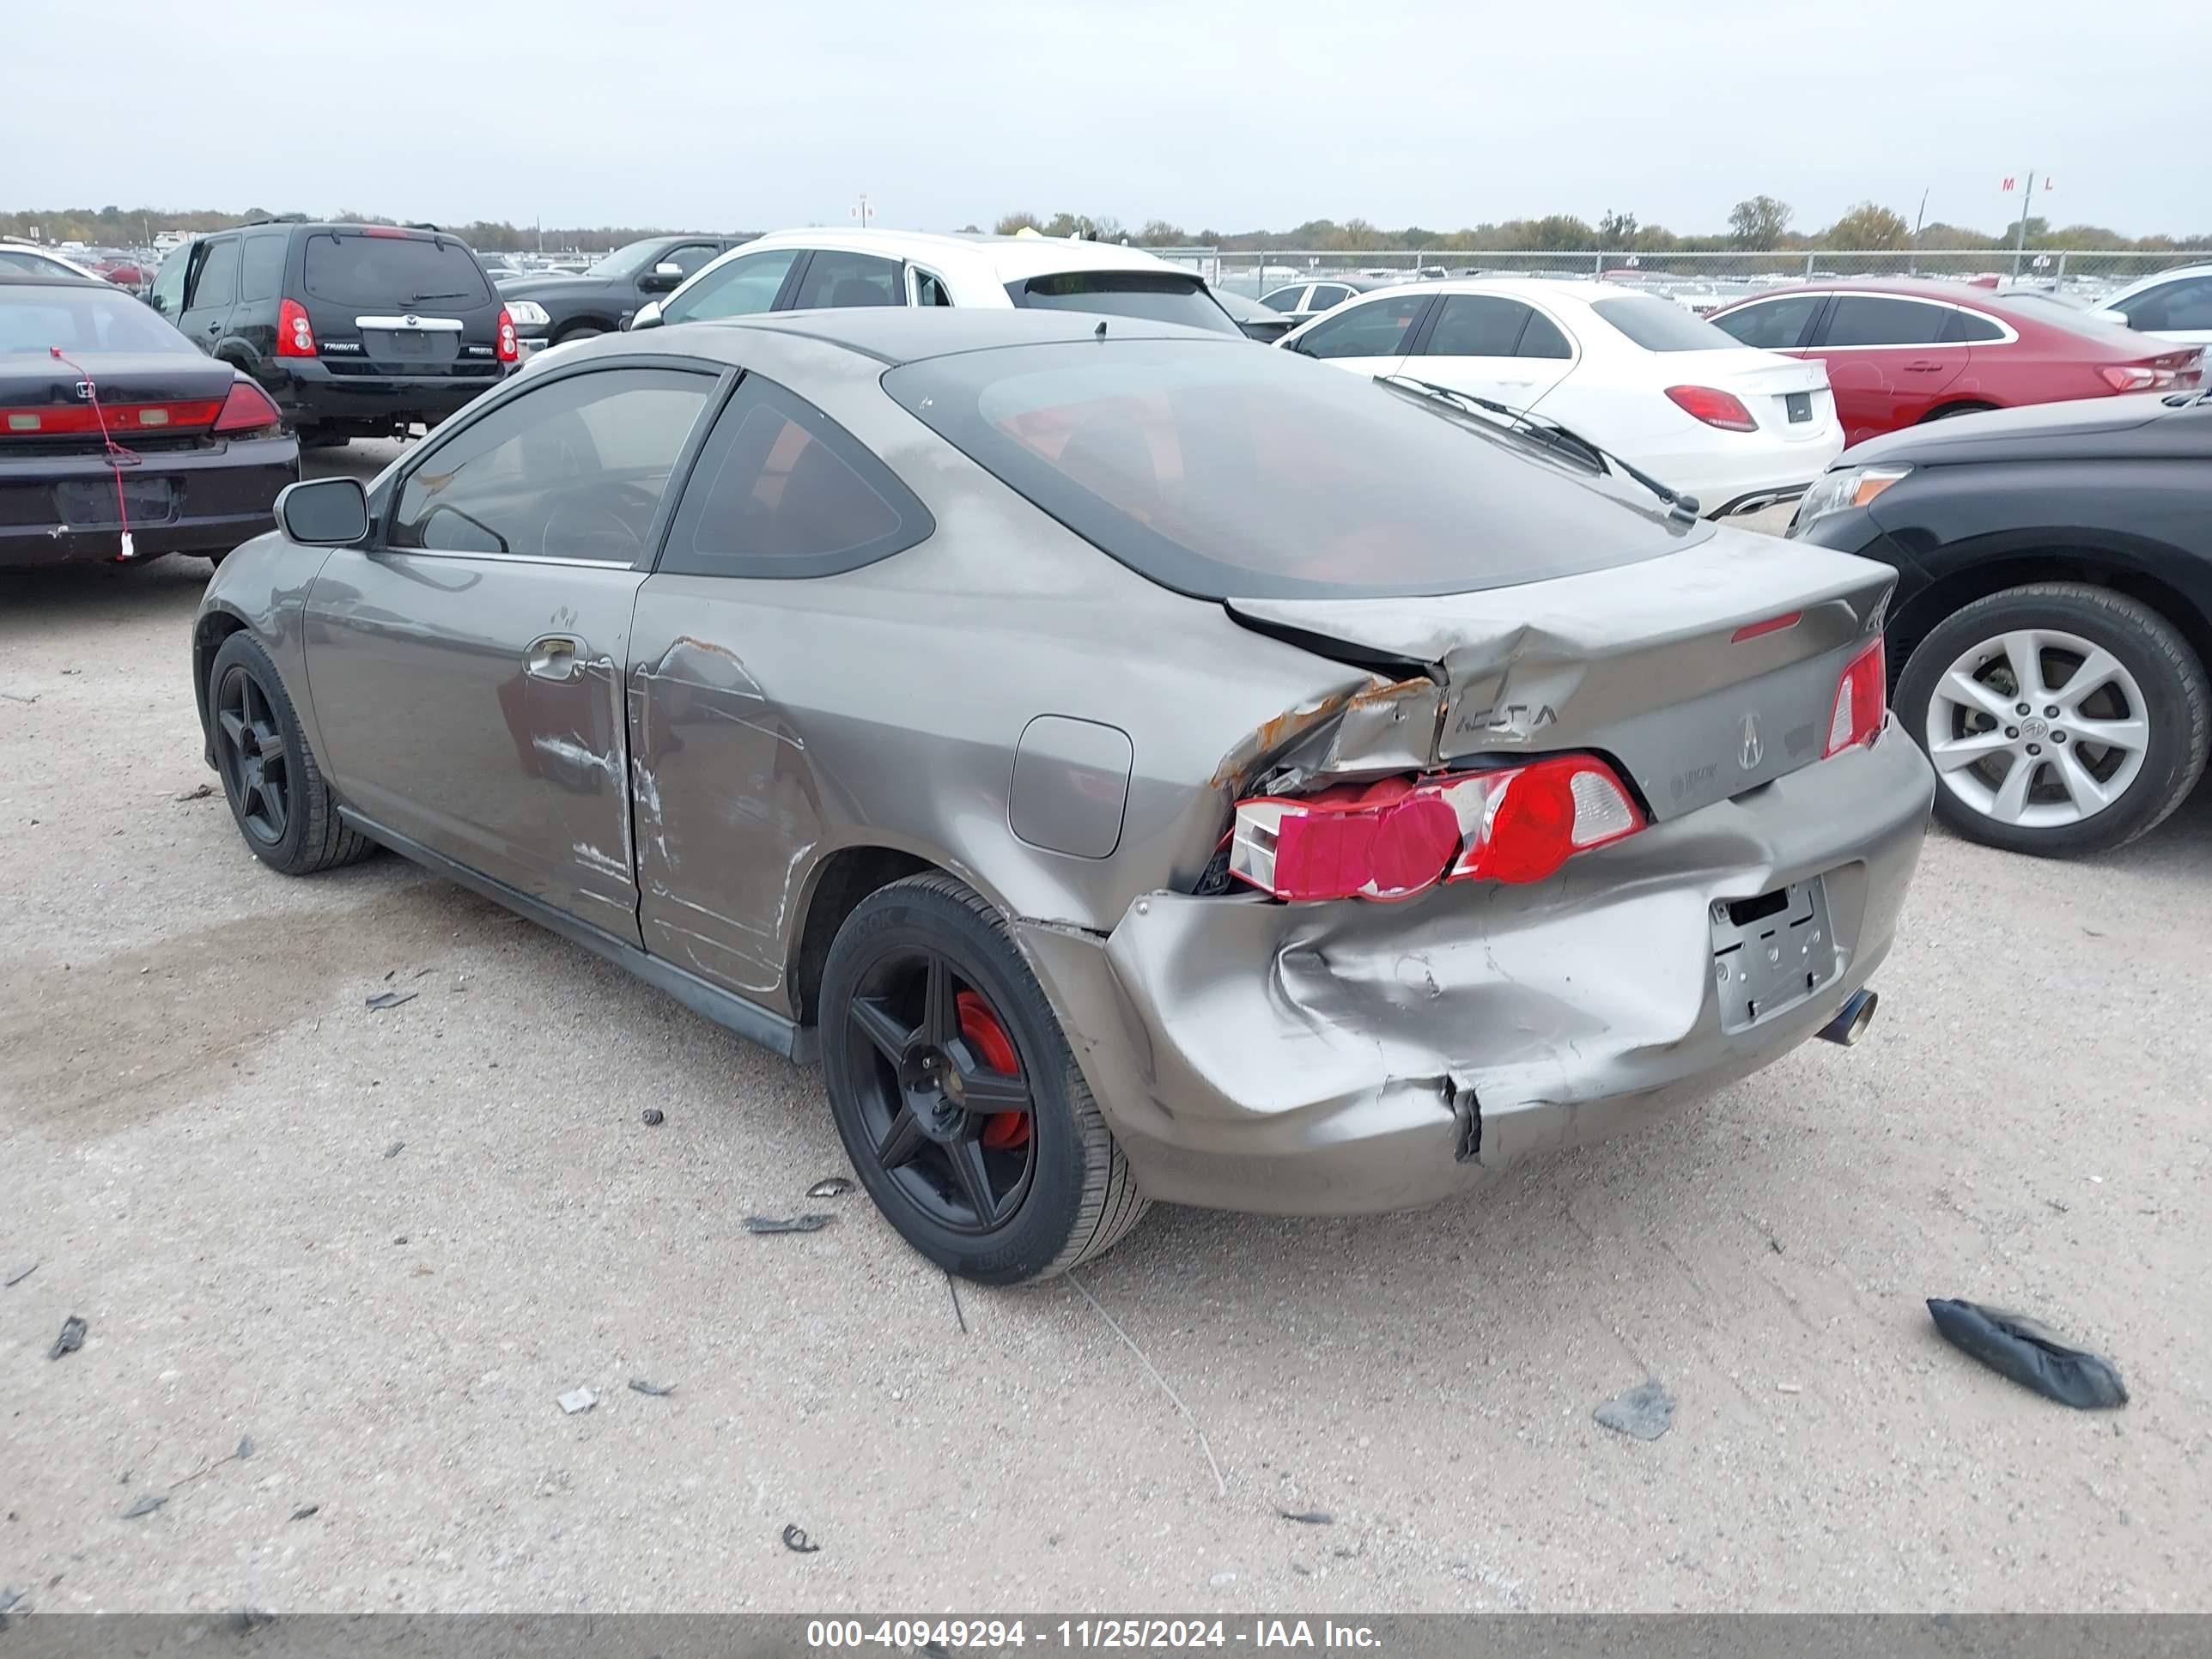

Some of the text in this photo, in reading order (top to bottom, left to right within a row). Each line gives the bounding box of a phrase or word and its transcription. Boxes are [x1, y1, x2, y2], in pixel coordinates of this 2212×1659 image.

[2002, 177, 2015, 191] M
[2045, 176, 2054, 191] L
[323, 343, 361, 351] TRIBUTE
